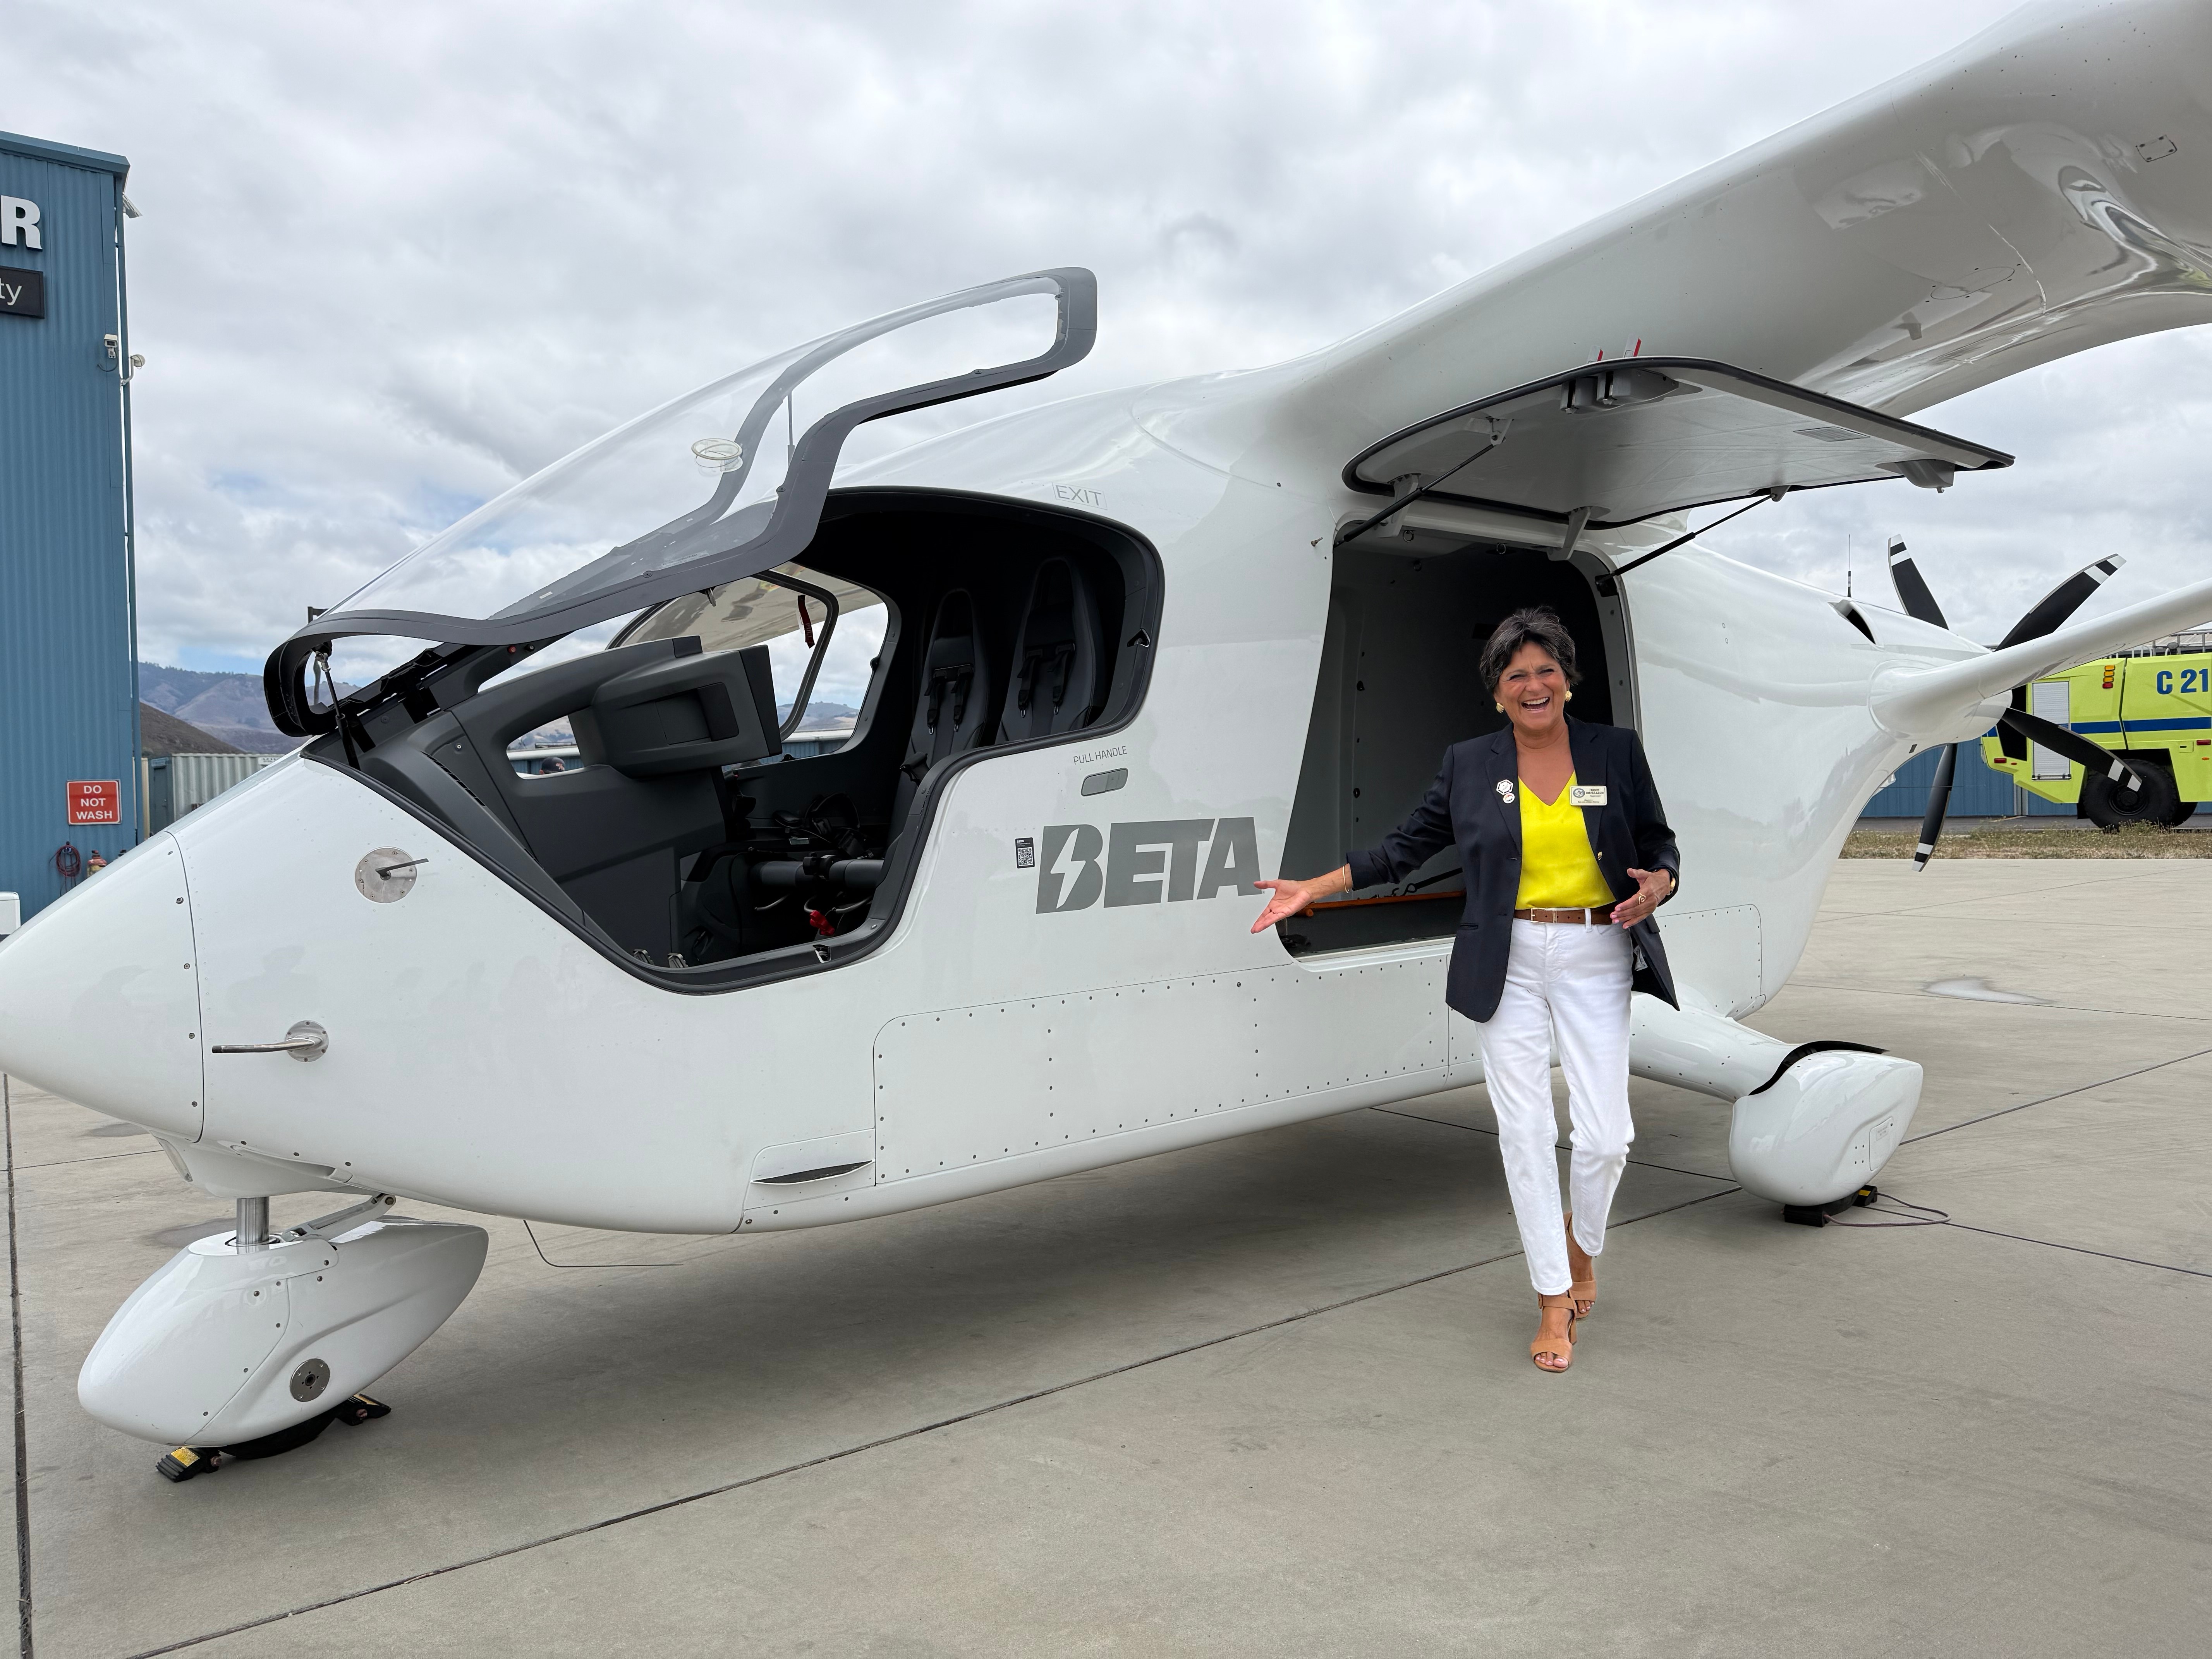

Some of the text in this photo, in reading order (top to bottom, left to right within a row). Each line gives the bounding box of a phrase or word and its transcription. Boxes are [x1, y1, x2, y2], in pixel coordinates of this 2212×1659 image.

[1, 195, 43, 250] R
[1056, 485, 1102, 506] EXIT
[2157, 668, 2209, 695] C 21
[1073, 745, 1128, 765] PULL HANDLE
[83, 785, 102, 794] DO
[81, 798, 106, 807] NOT
[76, 811, 112, 820] WASH
[1036, 817, 1262, 914] BETA
